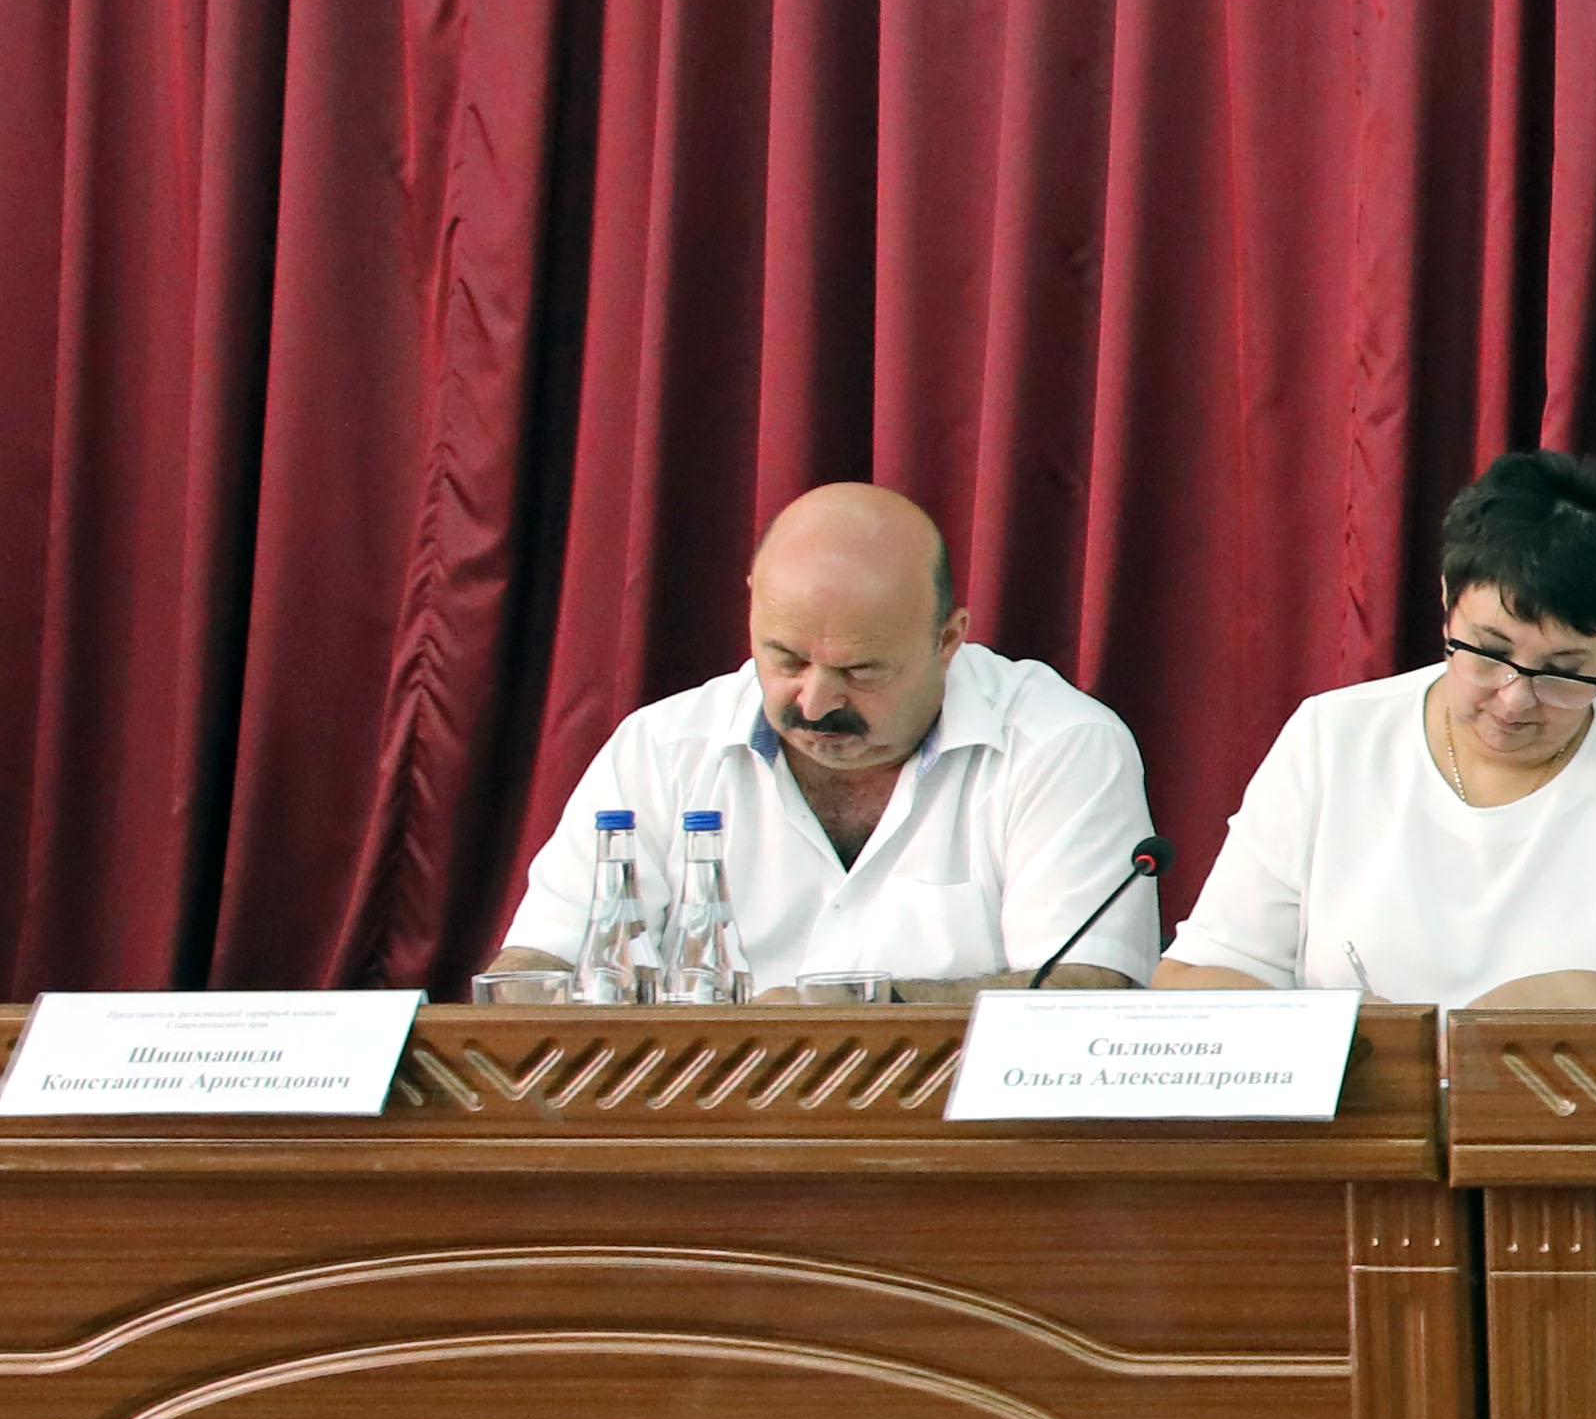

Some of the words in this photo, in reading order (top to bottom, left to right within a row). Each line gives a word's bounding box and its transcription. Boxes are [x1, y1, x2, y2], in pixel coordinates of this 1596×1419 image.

[128, 1047, 283, 1062] Шишманиди
[1088, 1038, 1222, 1055] Силюкова
[41, 1075, 183, 1090] Константин
[191, 1074, 349, 1093] Аристидович
[1003, 1069, 1082, 1086] Ольга
[1091, 1069, 1292, 1090] Александровна
